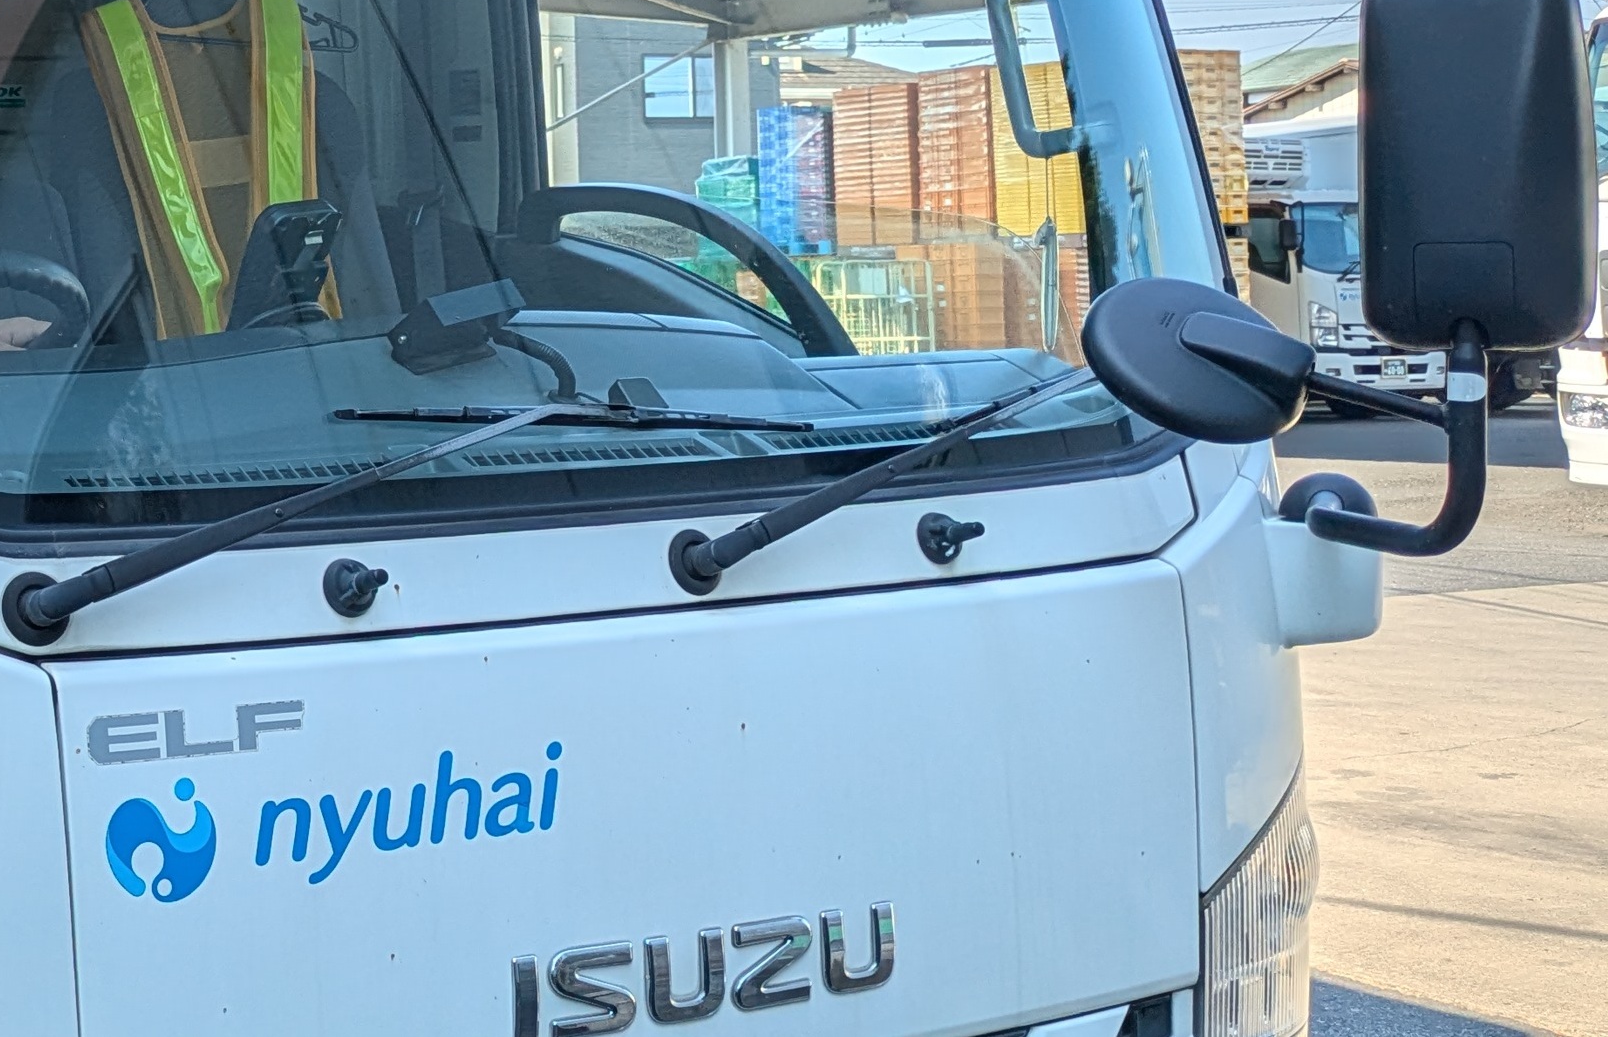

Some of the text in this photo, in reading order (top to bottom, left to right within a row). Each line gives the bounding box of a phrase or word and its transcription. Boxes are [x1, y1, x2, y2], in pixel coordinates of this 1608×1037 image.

[87, 699, 304, 765] ELF
[255, 741, 563, 885] nyuhai
[511, 900, 895, 1037] ISUZU
